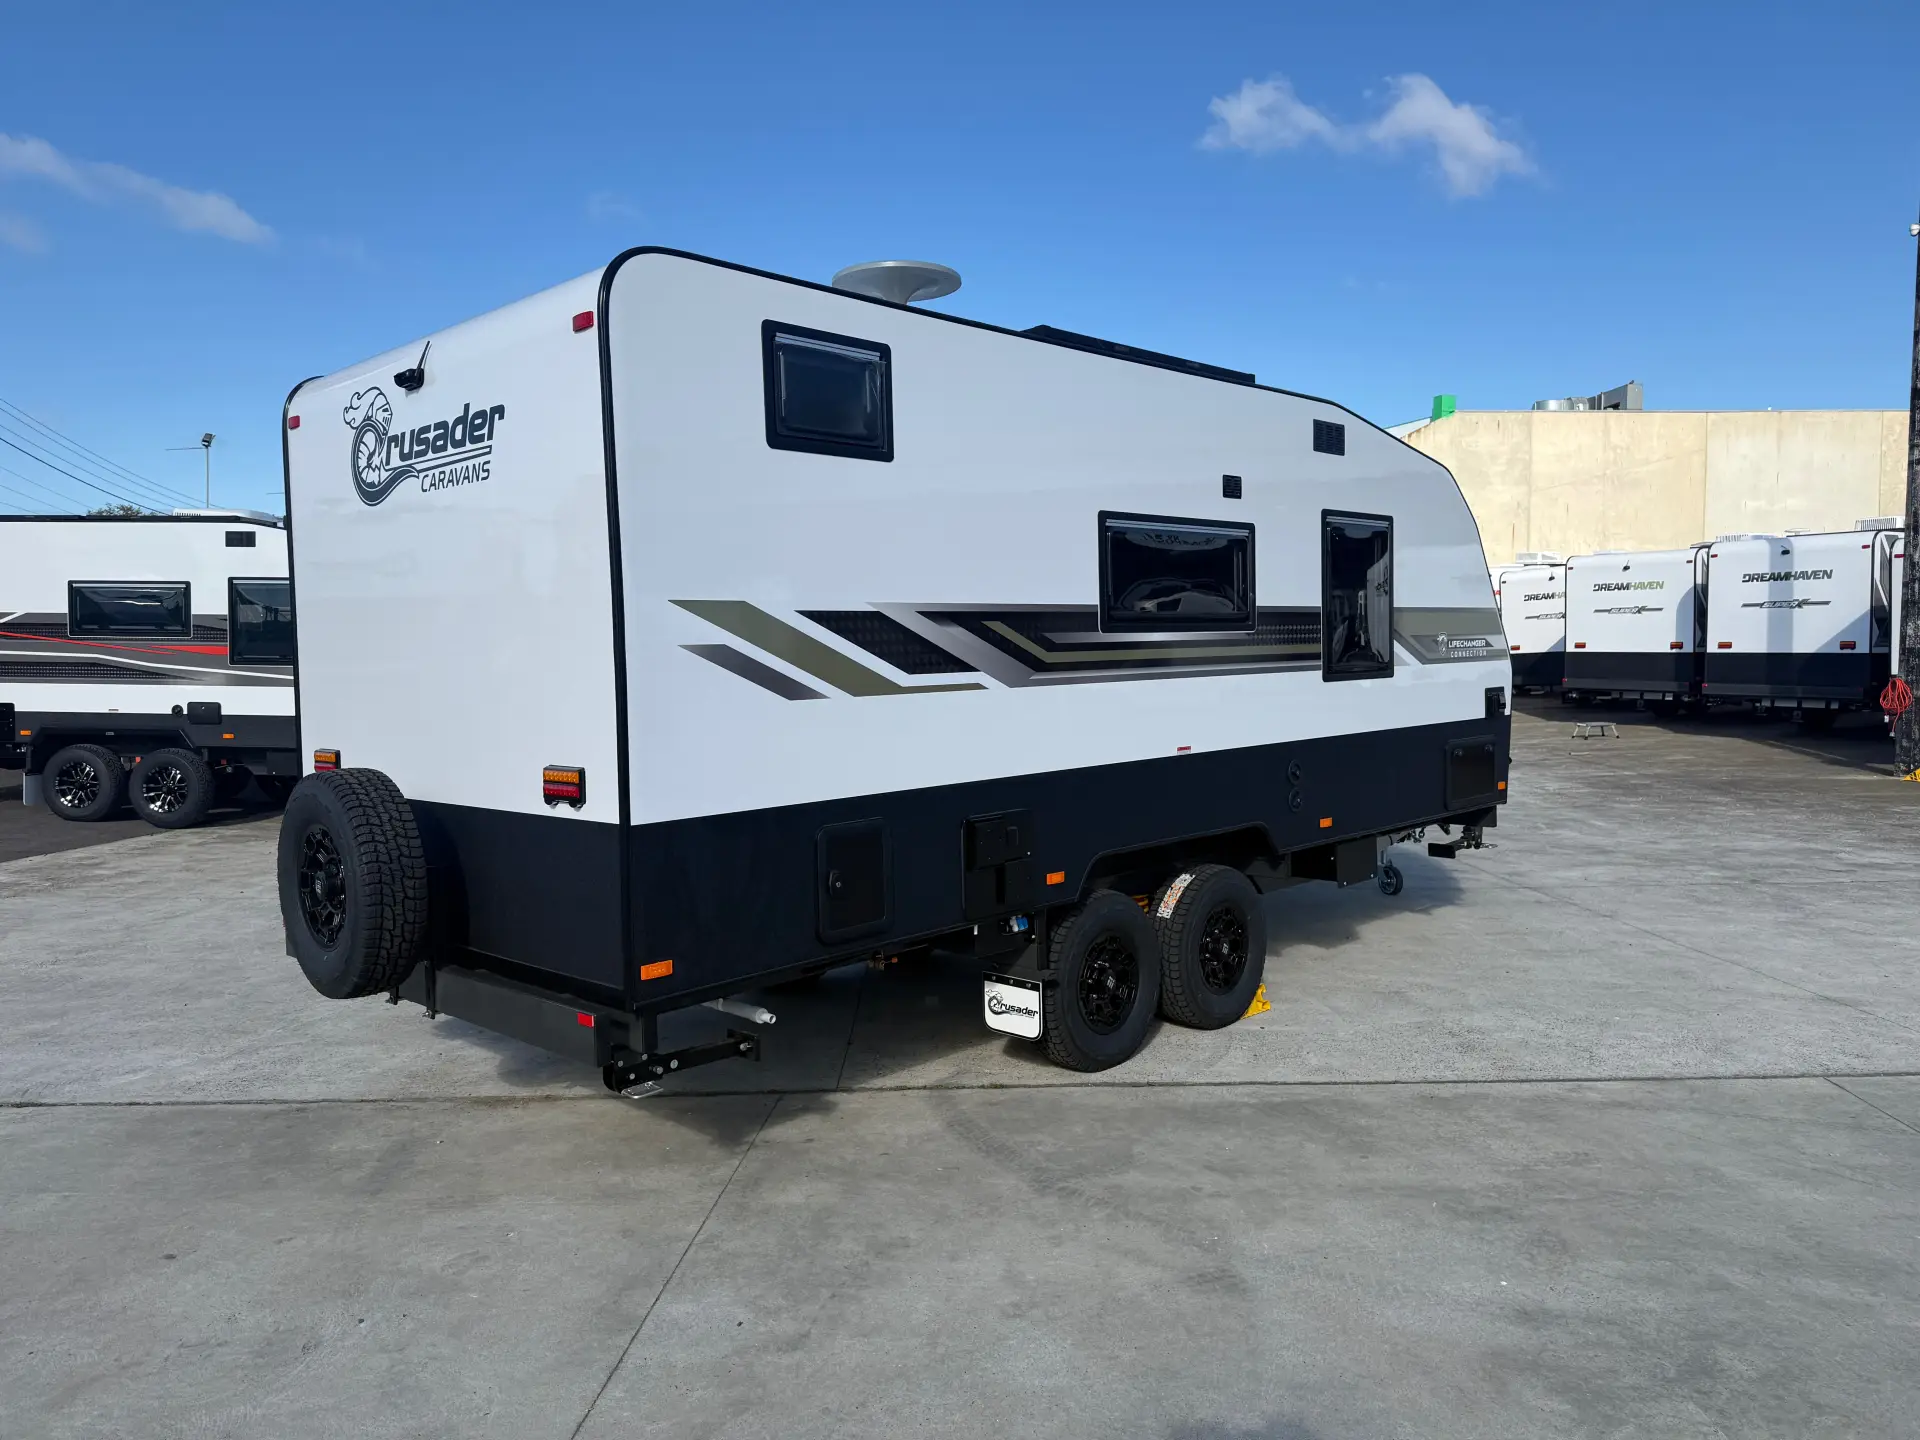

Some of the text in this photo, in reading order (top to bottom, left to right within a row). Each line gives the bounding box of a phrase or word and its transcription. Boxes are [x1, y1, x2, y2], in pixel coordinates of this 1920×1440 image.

[352, 402, 505, 507] Crusader
[421, 460, 491, 493] CARAVANS
[1742, 569, 1833, 583] DREAMHAVEN
[1593, 581, 1664, 592] DREAMHAVEN
[1524, 592, 1566, 602] DREAMHA
[1448, 639, 1486, 648] LIFECHANGER
[1450, 649, 1487, 658] CONNECTION
[988, 996, 1039, 1017] Crusader
